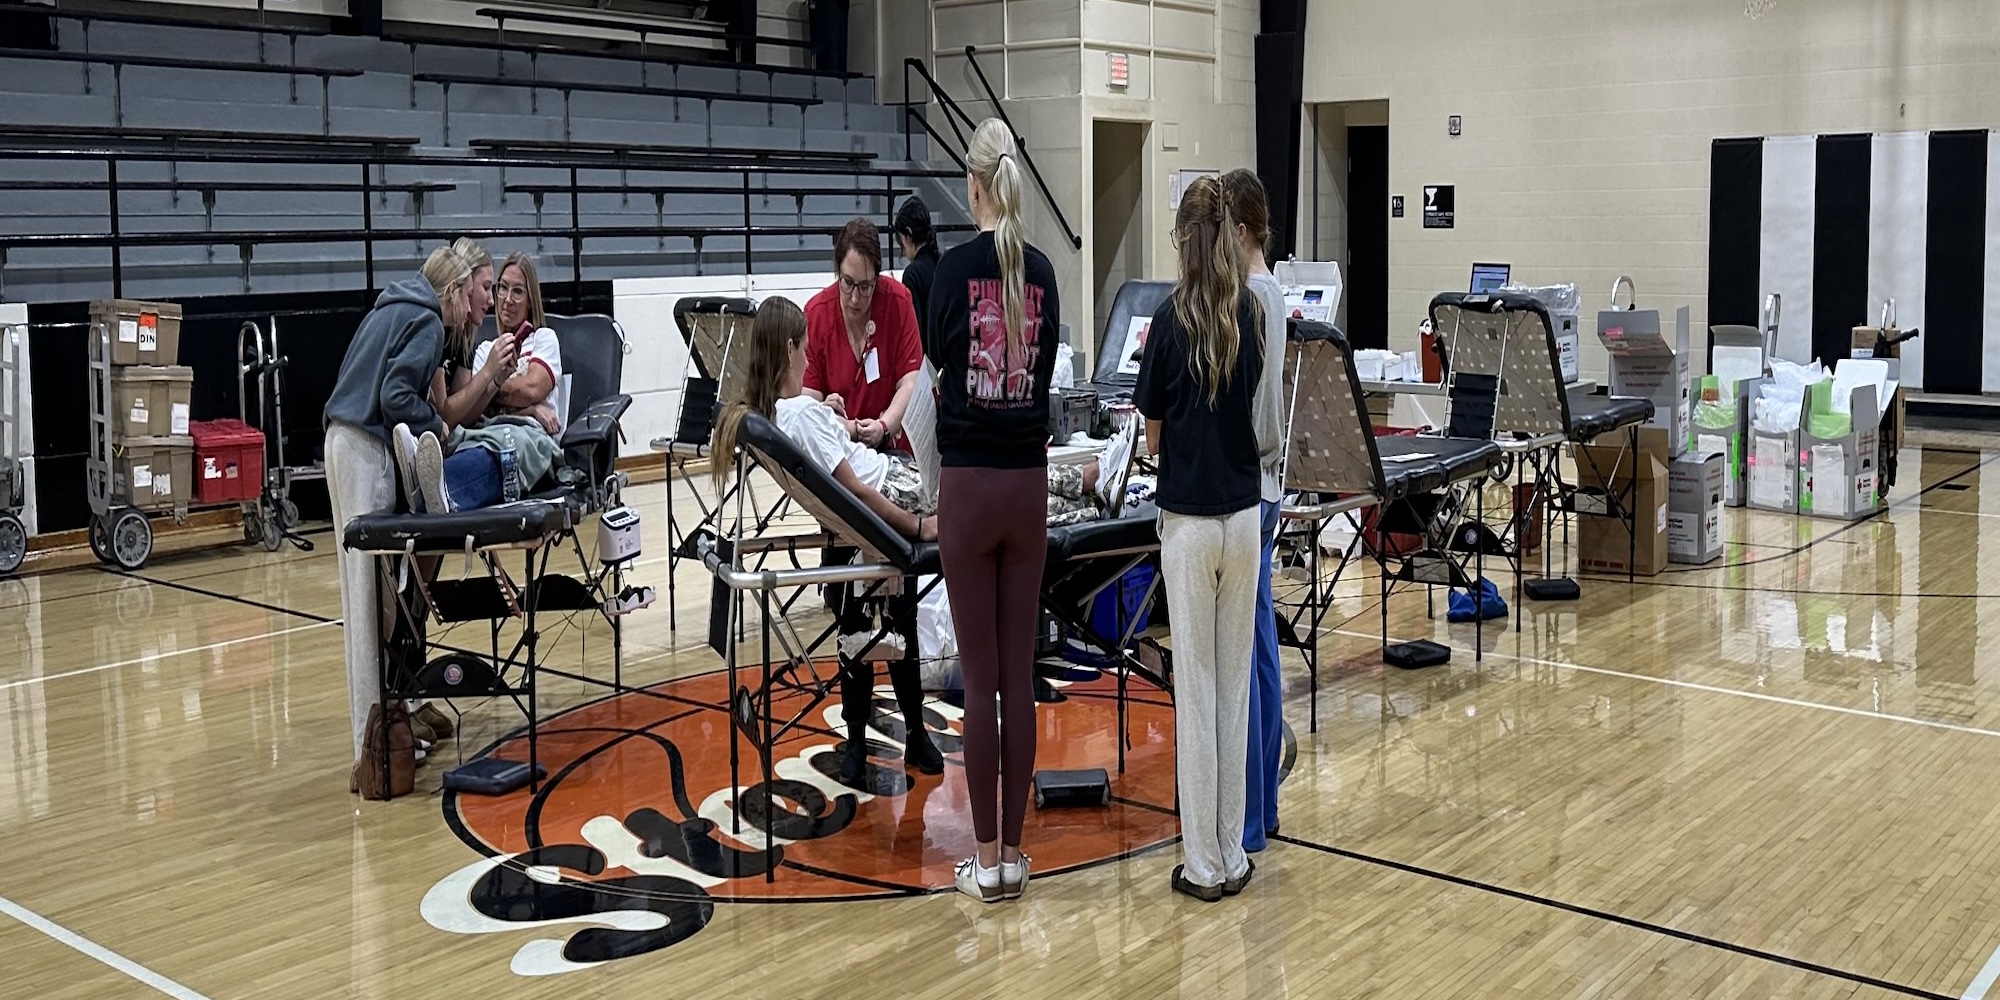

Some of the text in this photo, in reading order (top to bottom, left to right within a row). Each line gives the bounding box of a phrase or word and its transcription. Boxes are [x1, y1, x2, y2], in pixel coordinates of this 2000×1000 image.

[1023, 283, 1045, 315] UT
[140, 334, 155, 343] DIN
[966, 367, 1005, 400] PINK
